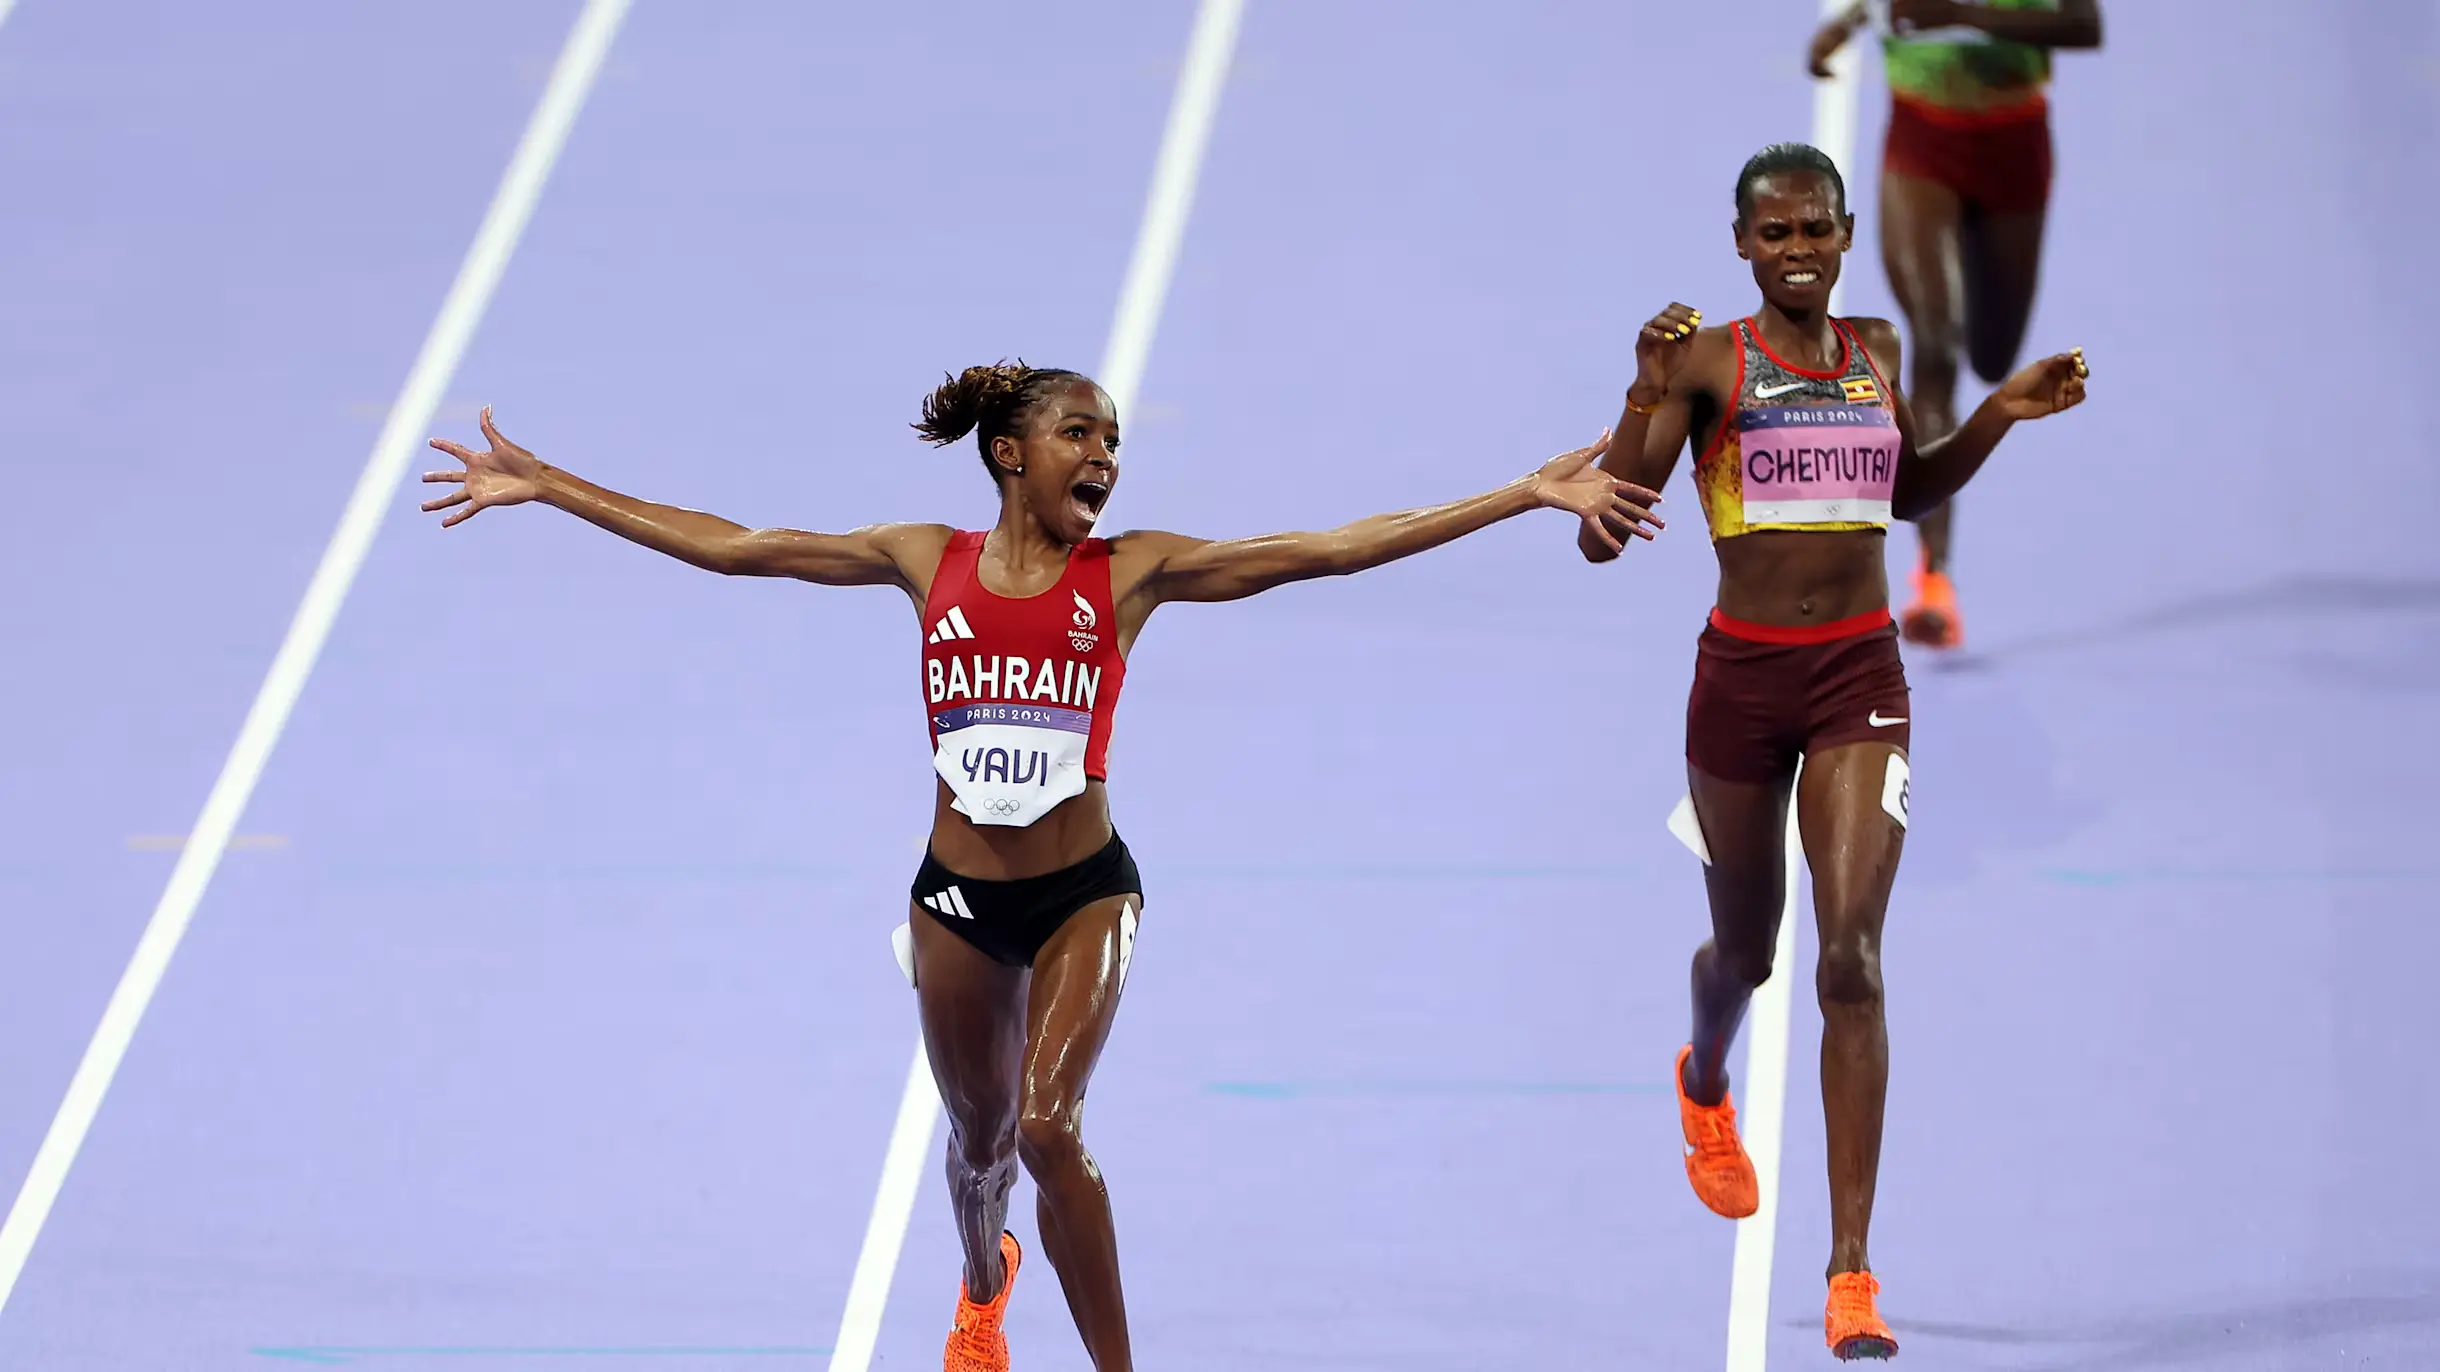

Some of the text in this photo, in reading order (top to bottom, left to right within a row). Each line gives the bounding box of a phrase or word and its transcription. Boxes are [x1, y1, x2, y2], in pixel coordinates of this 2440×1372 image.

[1783, 410, 1863, 423] PARIS 2024
[1747, 447, 1892, 484] CHEMUTAI
[1067, 630, 1099, 642] BAHRAIN
[928, 654, 1101, 710] BAHRAIN
[966, 708, 1051, 723] PARIS 2024
[962, 747, 1048, 787] YAVI
